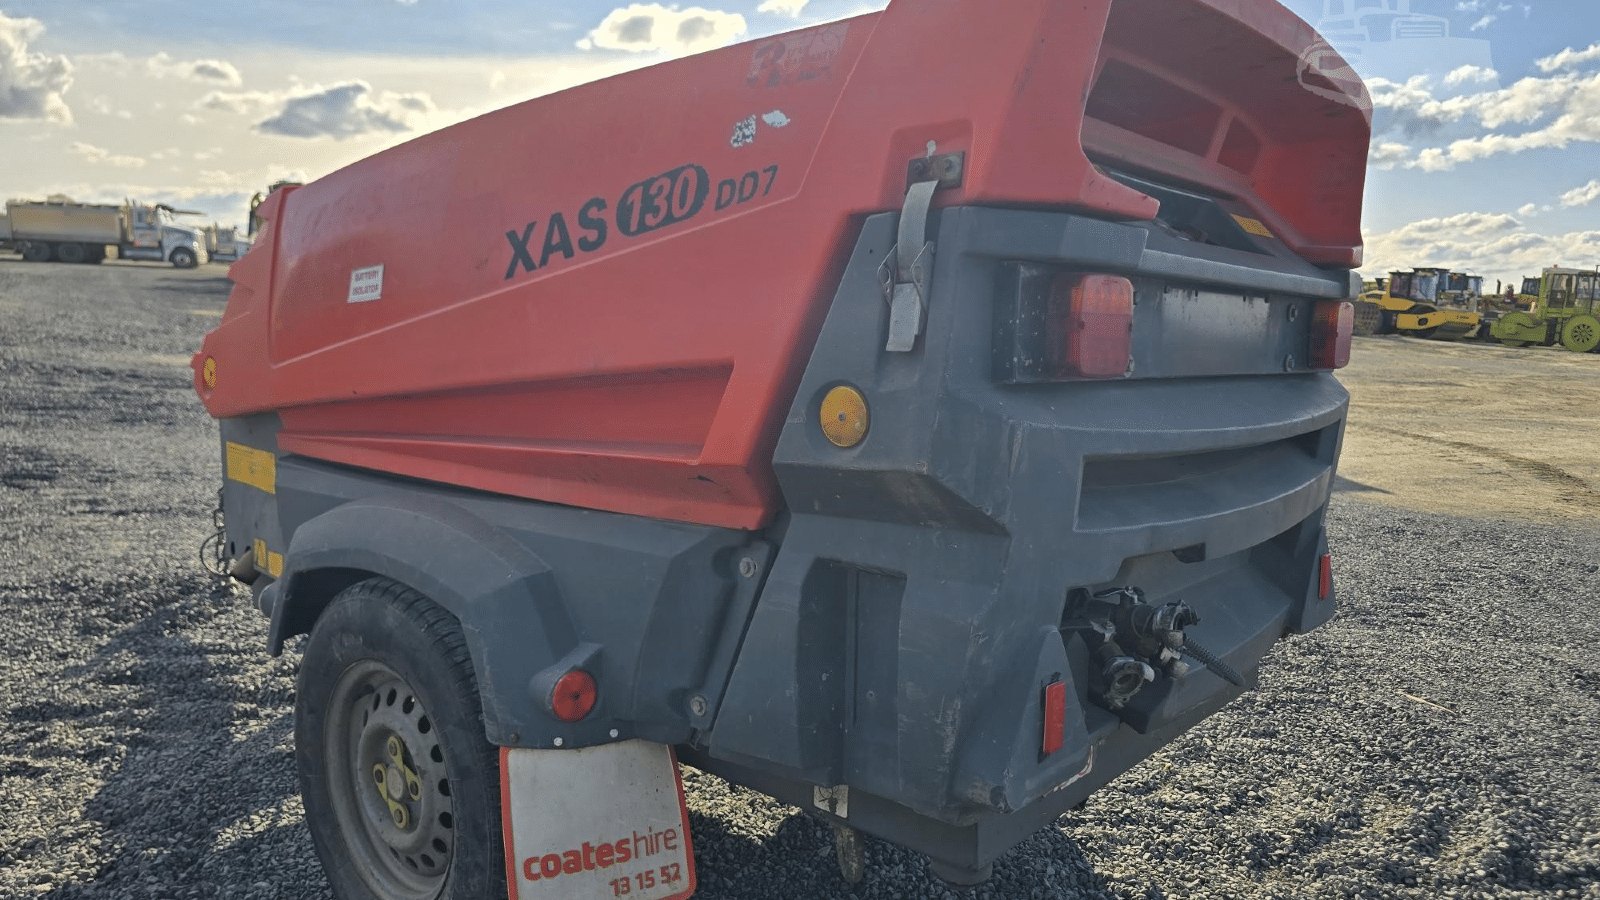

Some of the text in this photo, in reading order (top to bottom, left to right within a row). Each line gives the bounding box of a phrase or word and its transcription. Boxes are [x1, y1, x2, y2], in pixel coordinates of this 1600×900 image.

[504, 197, 608, 281] XAS
[625, 167, 699, 234] 130
[715, 164, 779, 212] DD7
[609, 862, 682, 897] 13 15 52
